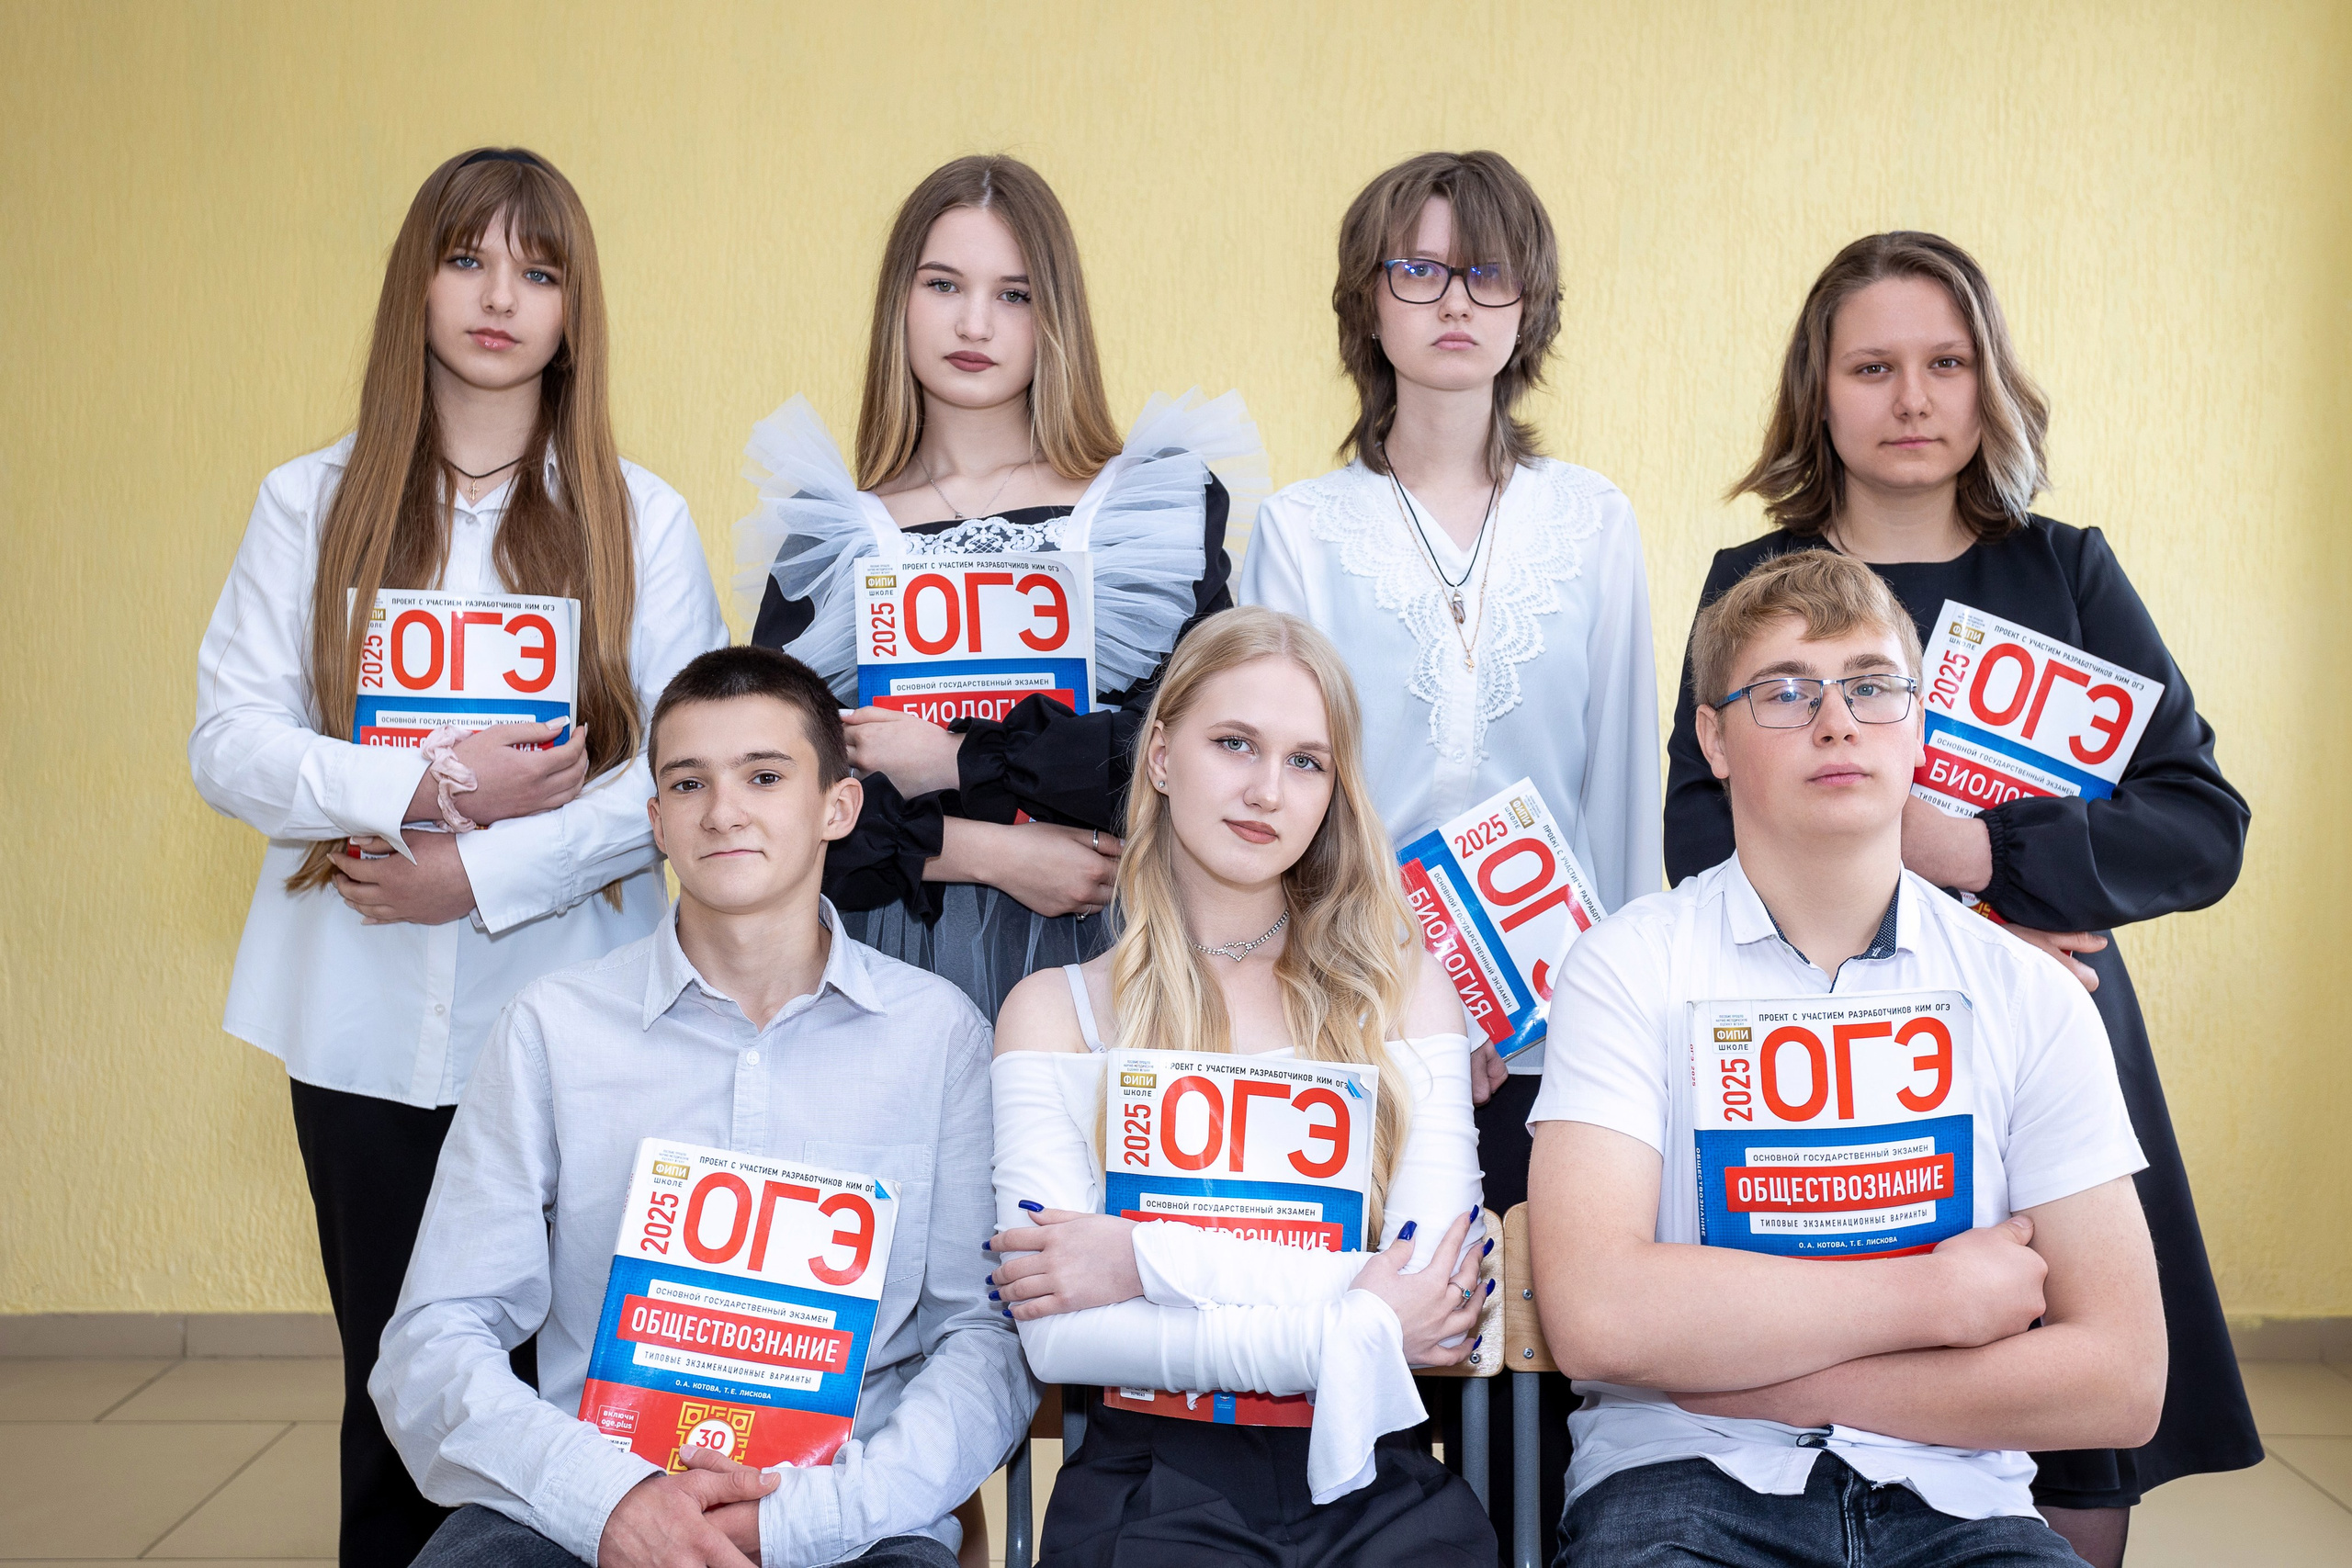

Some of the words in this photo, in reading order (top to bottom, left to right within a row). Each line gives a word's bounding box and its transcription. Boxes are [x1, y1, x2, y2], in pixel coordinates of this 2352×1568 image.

[902, 562, 928, 570] ПРОЕКТ
[931, 561, 936, 570] С
[938, 560, 974, 569] УЧАСТИЕМ
[976, 560, 1029, 570] РАЗРАБОТЧИКОВ
[1031, 563, 1046, 571] КИМ
[867, 577, 895, 588] ФИПИ
[868, 589, 894, 597] ШКОЛЕ
[371, 609, 385, 620] ПИ
[391, 598, 416, 606] ПРОЕКТ
[426, 599, 462, 607] УЧАСТИЕМ
[465, 600, 522, 610] РАЗРАБОТЧИКОВ
[525, 603, 540, 611] КИМ
[902, 572, 1070, 656] ОГЭ
[870, 602, 898, 658] 2025
[361, 635, 384, 689] 2025
[390, 609, 557, 694] ОГЭ
[1994, 625, 2020, 640] ПРОЕКТ
[2021, 635, 2028, 643] С
[2029, 637, 2062, 657] УЧАСТИЕМ
[2062, 651, 2113, 679] РАЗРАБОТЧИКОВ
[2114, 672, 2131, 686] КИМ
[2131, 680, 2145, 692] ОГЭ
[896, 682, 936, 692] ОСНОВНОЙ
[939, 678, 1012, 689] ГОСУДАРСТВЕННЫЙ
[1928, 649, 1971, 710] 2025
[1968, 642, 2134, 765] ОГЭ
[381, 716, 417, 725] ОСНОВНОЙ
[419, 717, 492, 727] ГОСУДАРСТВЕННЫЙ
[1936, 737, 1978, 757] ОСНОВНОЙ
[1979, 752, 2045, 784] ГОСУДАРСТВЕННЫЙ
[2045, 779, 2075, 796] ЭКЗАМЕН
[1512, 799, 1532, 827] ФИПИ
[1918, 792, 1952, 810] ТИПОВЫЕ
[1504, 806, 1521, 829] ШКОЛЕ
[1454, 813, 1509, 859] 2025
[1543, 824, 1560, 849] ПРОЕКТ
[1407, 886, 1494, 1021] БИОЛОГИЯ
[1433, 872, 1458, 908] ОСНОВНОЙ
[1453, 908, 1496, 976] ГОСУДАРСТВЕННЫЙ
[1491, 976, 1513, 1009] ЭКЗАМЕН
[1758, 1013, 1789, 1021] ПРОЕКТ
[1802, 1011, 1845, 1021] УЧАСТИЕМ
[1848, 1005, 1912, 1019] РАЗРАБОТЧИКОВ
[1915, 1003, 1932, 1013] КИМ
[1935, 1003, 1951, 1011] ОГЭ
[1716, 1029, 1749, 1041] ФИПИ
[1123, 1074, 1154, 1087] ФИПИ
[1165, 1062, 1194, 1071] РОЕКТ
[1197, 1064, 1203, 1072] С
[1205, 1064, 1247, 1076] УЧАСТИЕМ
[1250, 1067, 1313, 1082] РАЗРАБОТЧИКОВ
[1316, 1076, 1333, 1086] КИМ
[1335, 1079, 1348, 1089] ОГЭ
[1759, 1016, 1953, 1122] ОГЭ
[1123, 1089, 1152, 1098] ШКОЛЕ
[1720, 1058, 1753, 1122] 2025
[1124, 1103, 1152, 1168] 2025
[1160, 1075, 1351, 1179] ОГЭ
[1753, 1153, 1800, 1162] ОСНОВНОЙ
[1803, 1148, 1890, 1163] ГОСУДАРСТВЕННЫЙ
[1892, 1144, 1928, 1156] ЭКЗАМЕН
[653, 1177, 684, 1188] ШКОЛЕ
[655, 1163, 687, 1178] ФИПИ
[699, 1156, 729, 1168] ПРОЕКТ
[730, 1161, 737, 1169] С
[739, 1162, 779, 1177] УЧАСТИЕМ
[781, 1169, 843, 1188] РАЗРАБОТЧИКОВ
[845, 1180, 863, 1192] КИМ
[865, 1184, 876, 1193] ОГ
[1695, 1147, 1706, 1237] ОБЩЕСТВОЗНАНИЕ
[1737, 1164, 1945, 1206] ОБЩЕСТВОЗНАНИЕ
[1146, 1200, 1190, 1211] ОСНОВНОЙ
[1193, 1202, 1273, 1213] ГОСУДАРСТВЕННЫЙ
[1276, 1207, 1316, 1216] ЭКЗАМЕН
[1759, 1219, 1799, 1228] ТИПОВЫЕ
[1803, 1214, 1886, 1229] ЭКЗАМЕНАЦИОННЫЕ
[1890, 1208, 1928, 1222] ВАРИАНТЫ
[639, 1190, 680, 1256] 2025
[683, 1171, 876, 1287] ОГЭ
[1816, 1240, 1848, 1249] КОТОВА,
[1866, 1235, 1898, 1247] ЛИСКОВА
[655, 1286, 701, 1302] ОСНОВНОЙ
[703, 1295, 787, 1316] ГОСУДАРСТВЕННЫЙ
[788, 1310, 829, 1324] ЭКЗАМЕН
[630, 1305, 841, 1364] ОБЩЕСТВОЗНАНИЕ
[644, 1350, 682, 1365] ТИПОВЫЕ
[685, 1358, 766, 1379] ЭКЗАМЕНАЦИОННЫЕ
[769, 1371, 812, 1385] ВАРИАНТЫ
[692, 1382, 722, 1394] КОТОВА,
[739, 1389, 772, 1400] ЛИСКОВА
[601, 1418, 633, 1429] oge.plus
[603, 1410, 635, 1421] включи
[695, 1428, 726, 1450] 30
